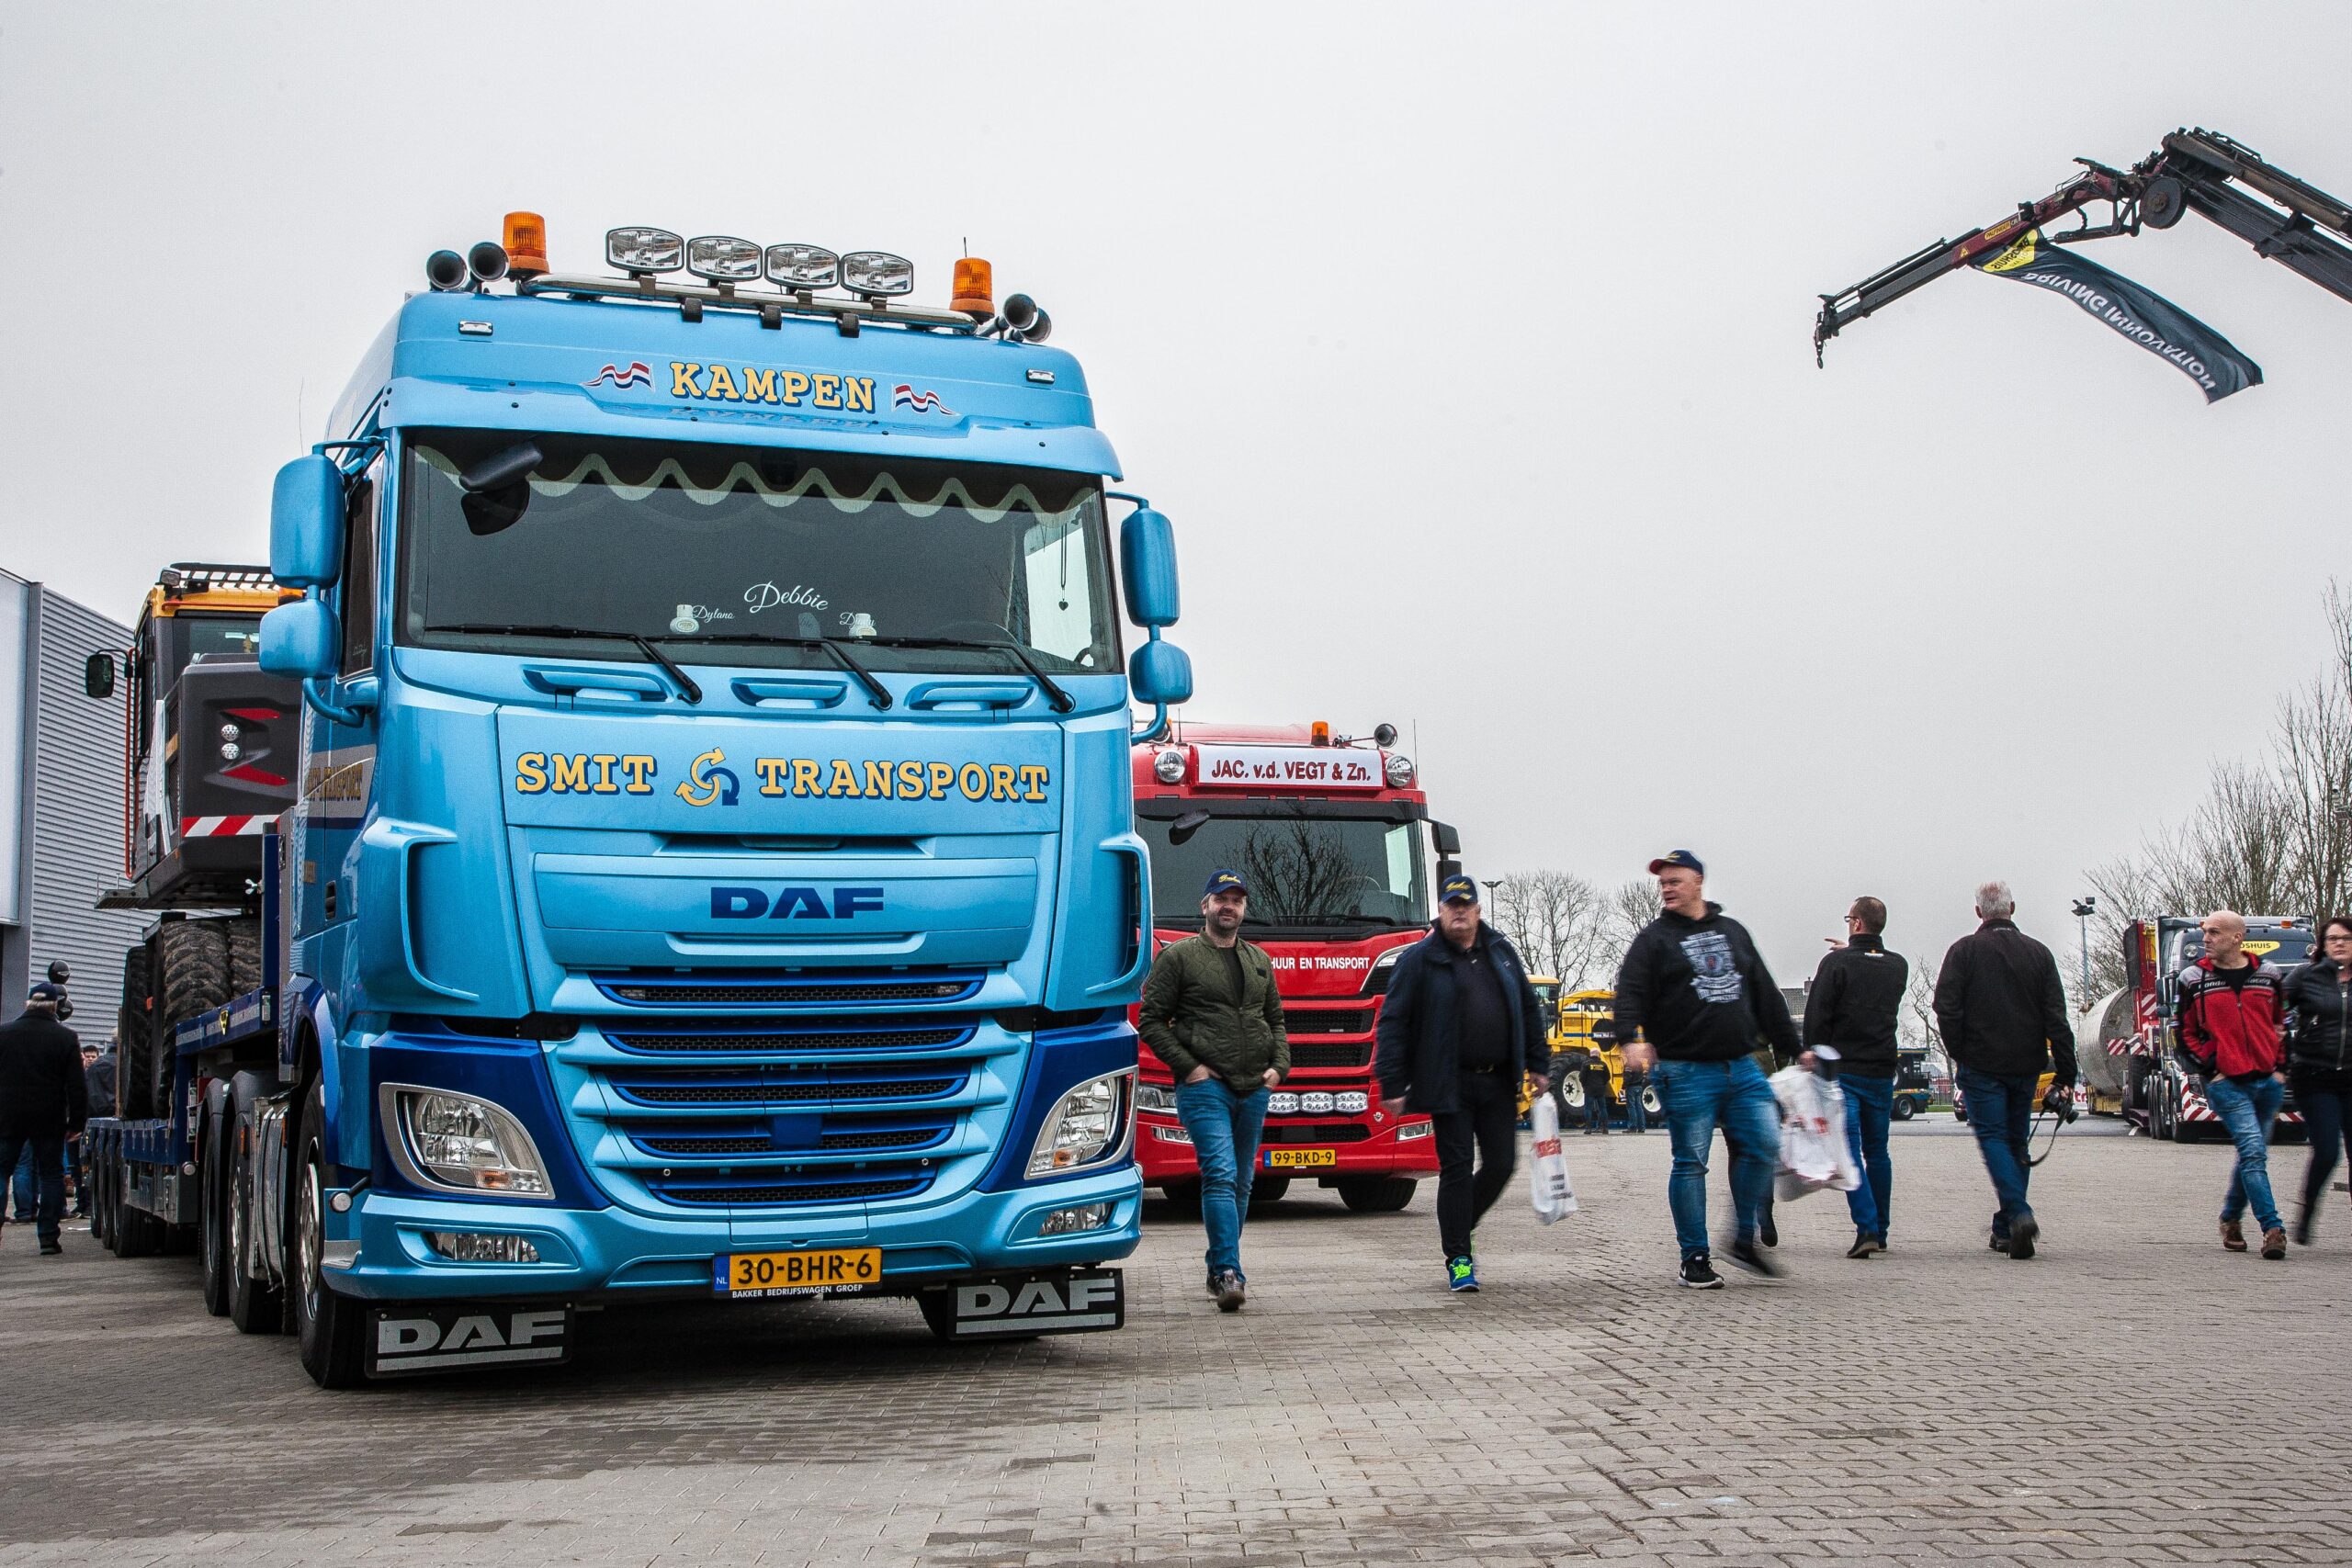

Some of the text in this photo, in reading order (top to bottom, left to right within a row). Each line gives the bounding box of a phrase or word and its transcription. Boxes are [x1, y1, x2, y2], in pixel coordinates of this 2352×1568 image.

[670, 361, 877, 413] KAMPEN
[743, 580, 829, 614] Debbie
[515, 751, 1051, 804] SMIT TRANSPORT
[1211, 760, 1372, 782] JAC. v.d. VEGT & Zn.
[710, 886, 885, 919] DAF
[1299, 957, 1312, 969] EN
[1315, 957, 1370, 969] TRANSPORT
[1274, 1151, 1332, 1164] 99-BKD-9
[716, 1277, 728, 1285] NL
[738, 1253, 873, 1285] 30-BHR-6
[732, 1284, 863, 1299] BAKKER BEDRIJFSWAGEN GROEP
[957, 1278, 1115, 1317] DAF
[378, 1310, 565, 1354] DAF
